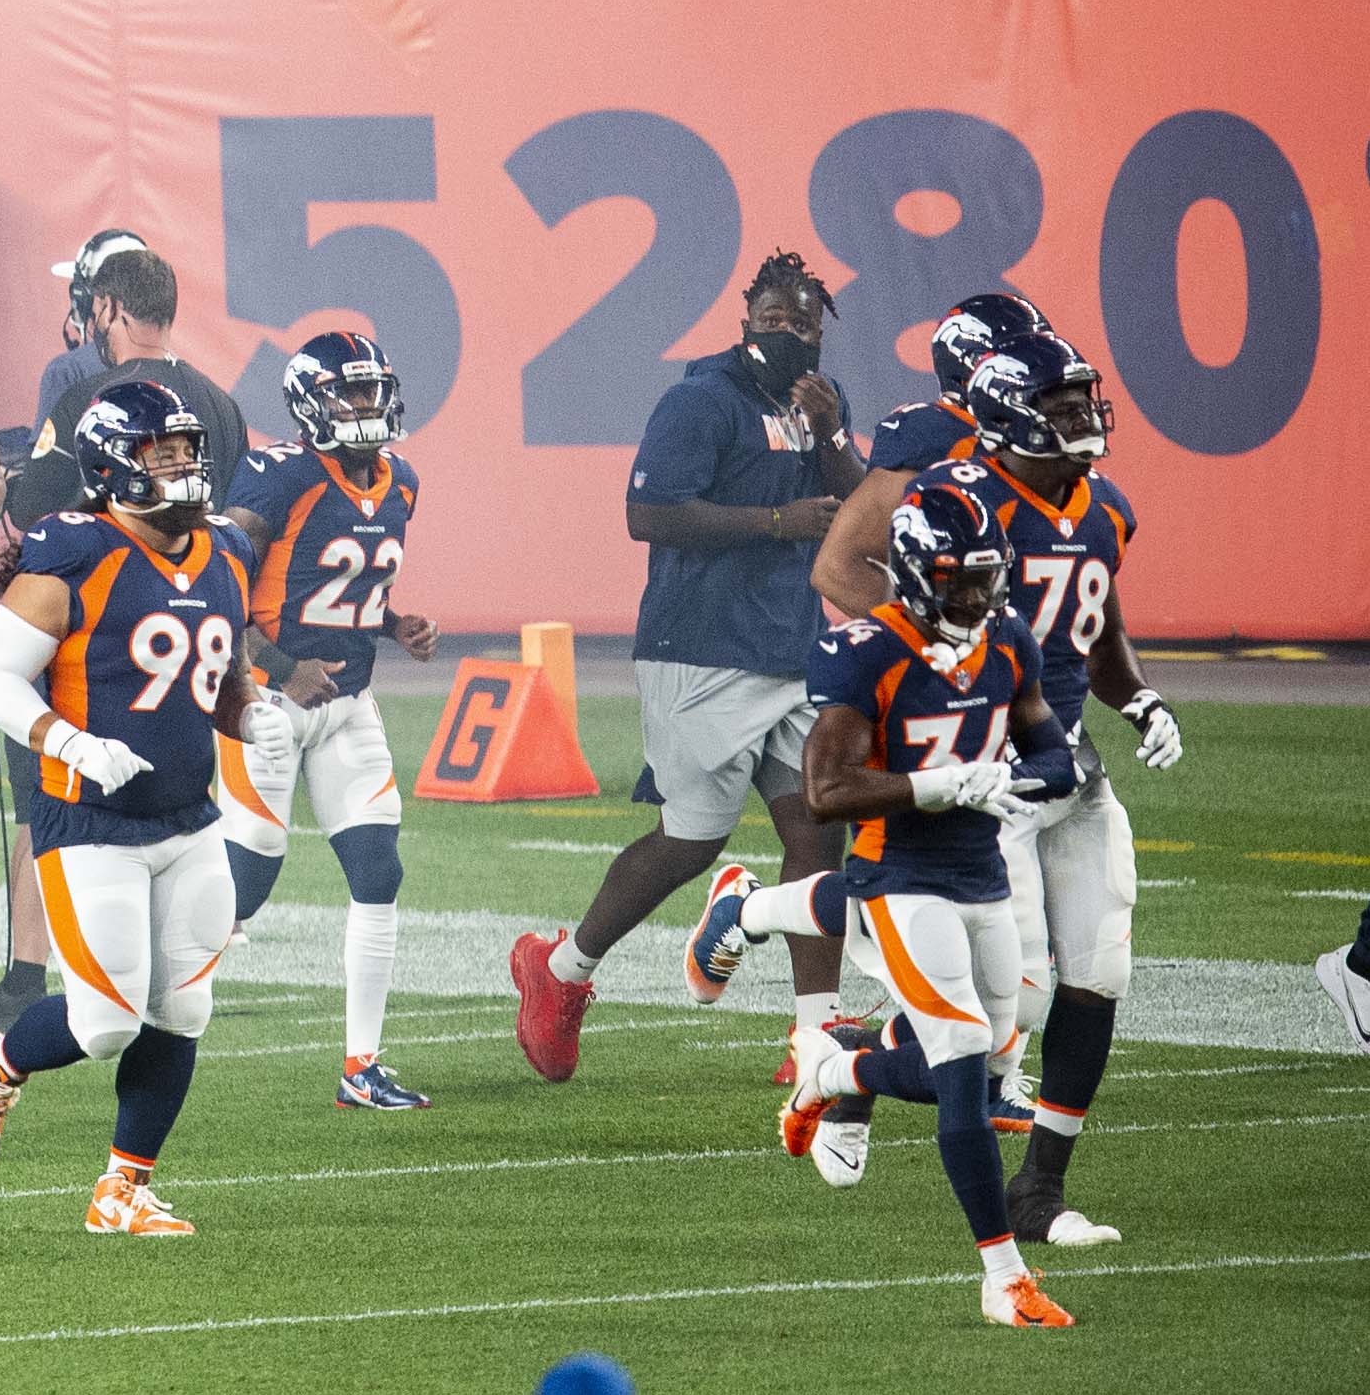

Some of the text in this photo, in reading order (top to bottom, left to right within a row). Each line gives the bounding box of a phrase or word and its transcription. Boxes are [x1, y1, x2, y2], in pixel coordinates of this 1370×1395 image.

[219, 108, 1322, 458] 5280
[300, 536, 404, 628] 22
[1023, 556, 1110, 656] 78
[128, 613, 235, 713] 98
[435, 676, 511, 781] G
